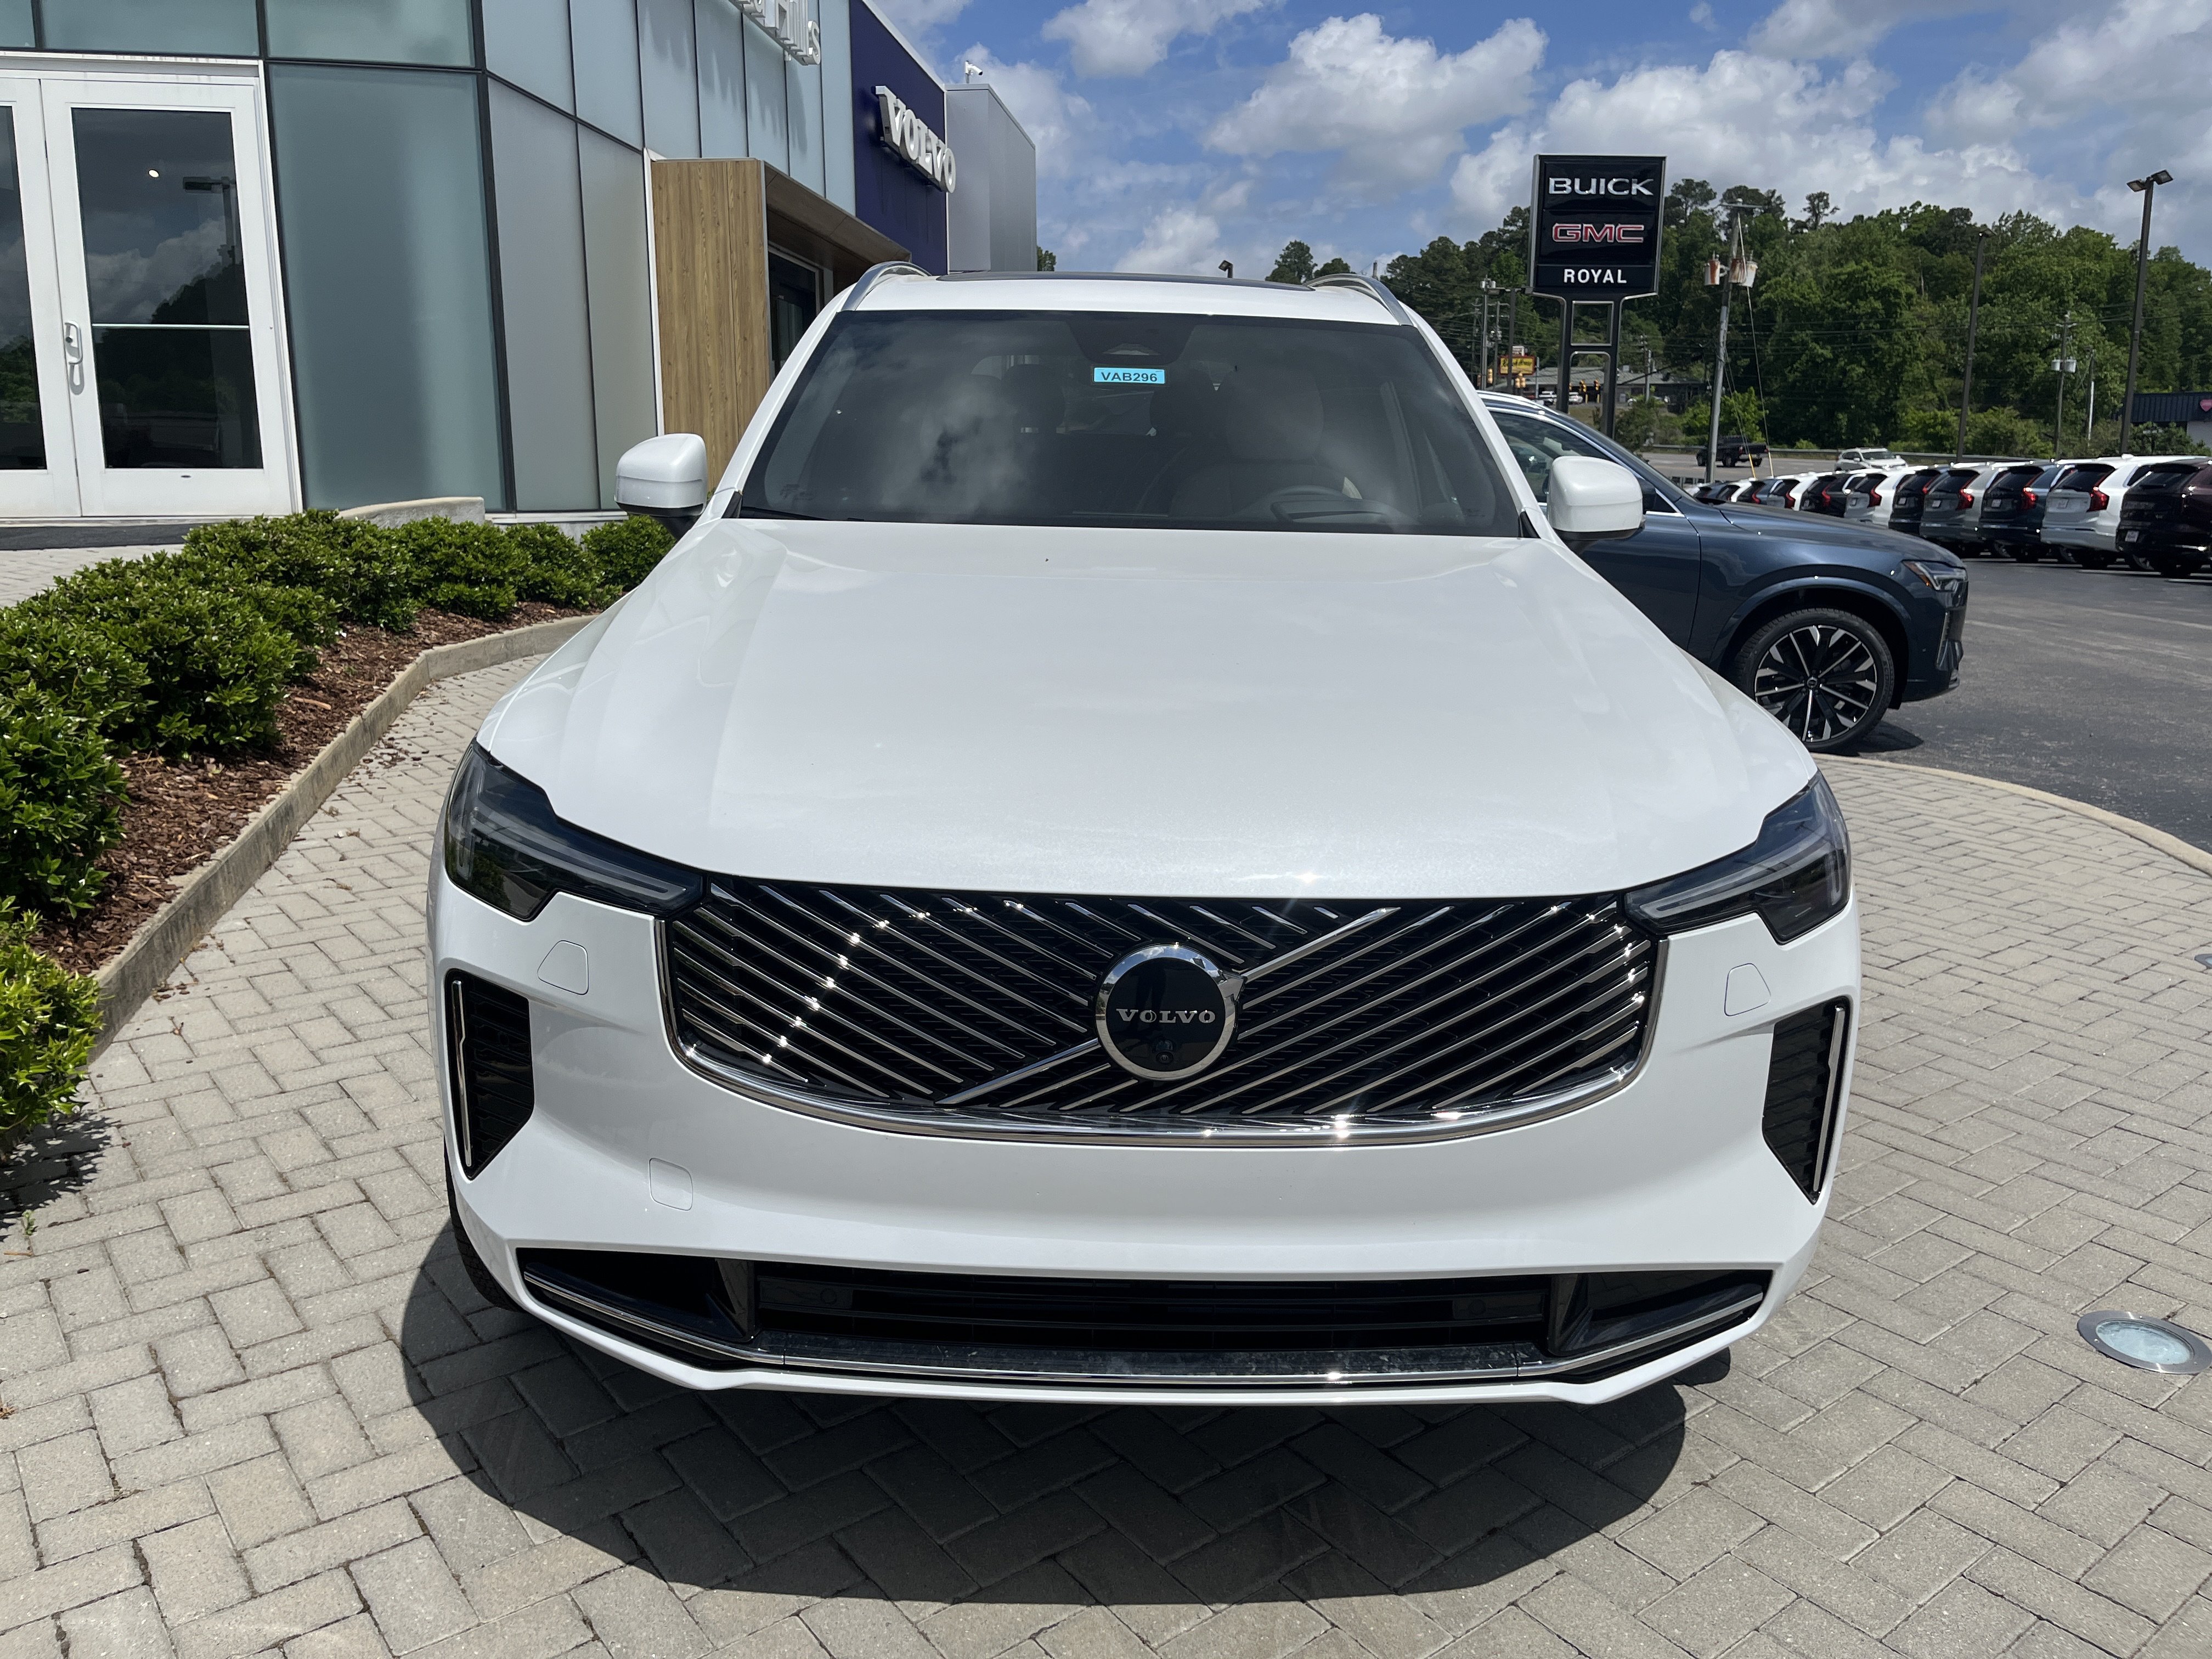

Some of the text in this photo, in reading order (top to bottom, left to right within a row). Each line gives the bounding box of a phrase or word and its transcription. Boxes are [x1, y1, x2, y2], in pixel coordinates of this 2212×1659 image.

[872, 85, 956, 193] VOLVO
[1548, 177, 1655, 196] BUICK
[1552, 223, 1645, 243] GMC
[1563, 269, 1627, 284] ROYAL
[1101, 371, 1158, 382] VAB296
[1116, 1008, 1216, 1024] VOLVO
